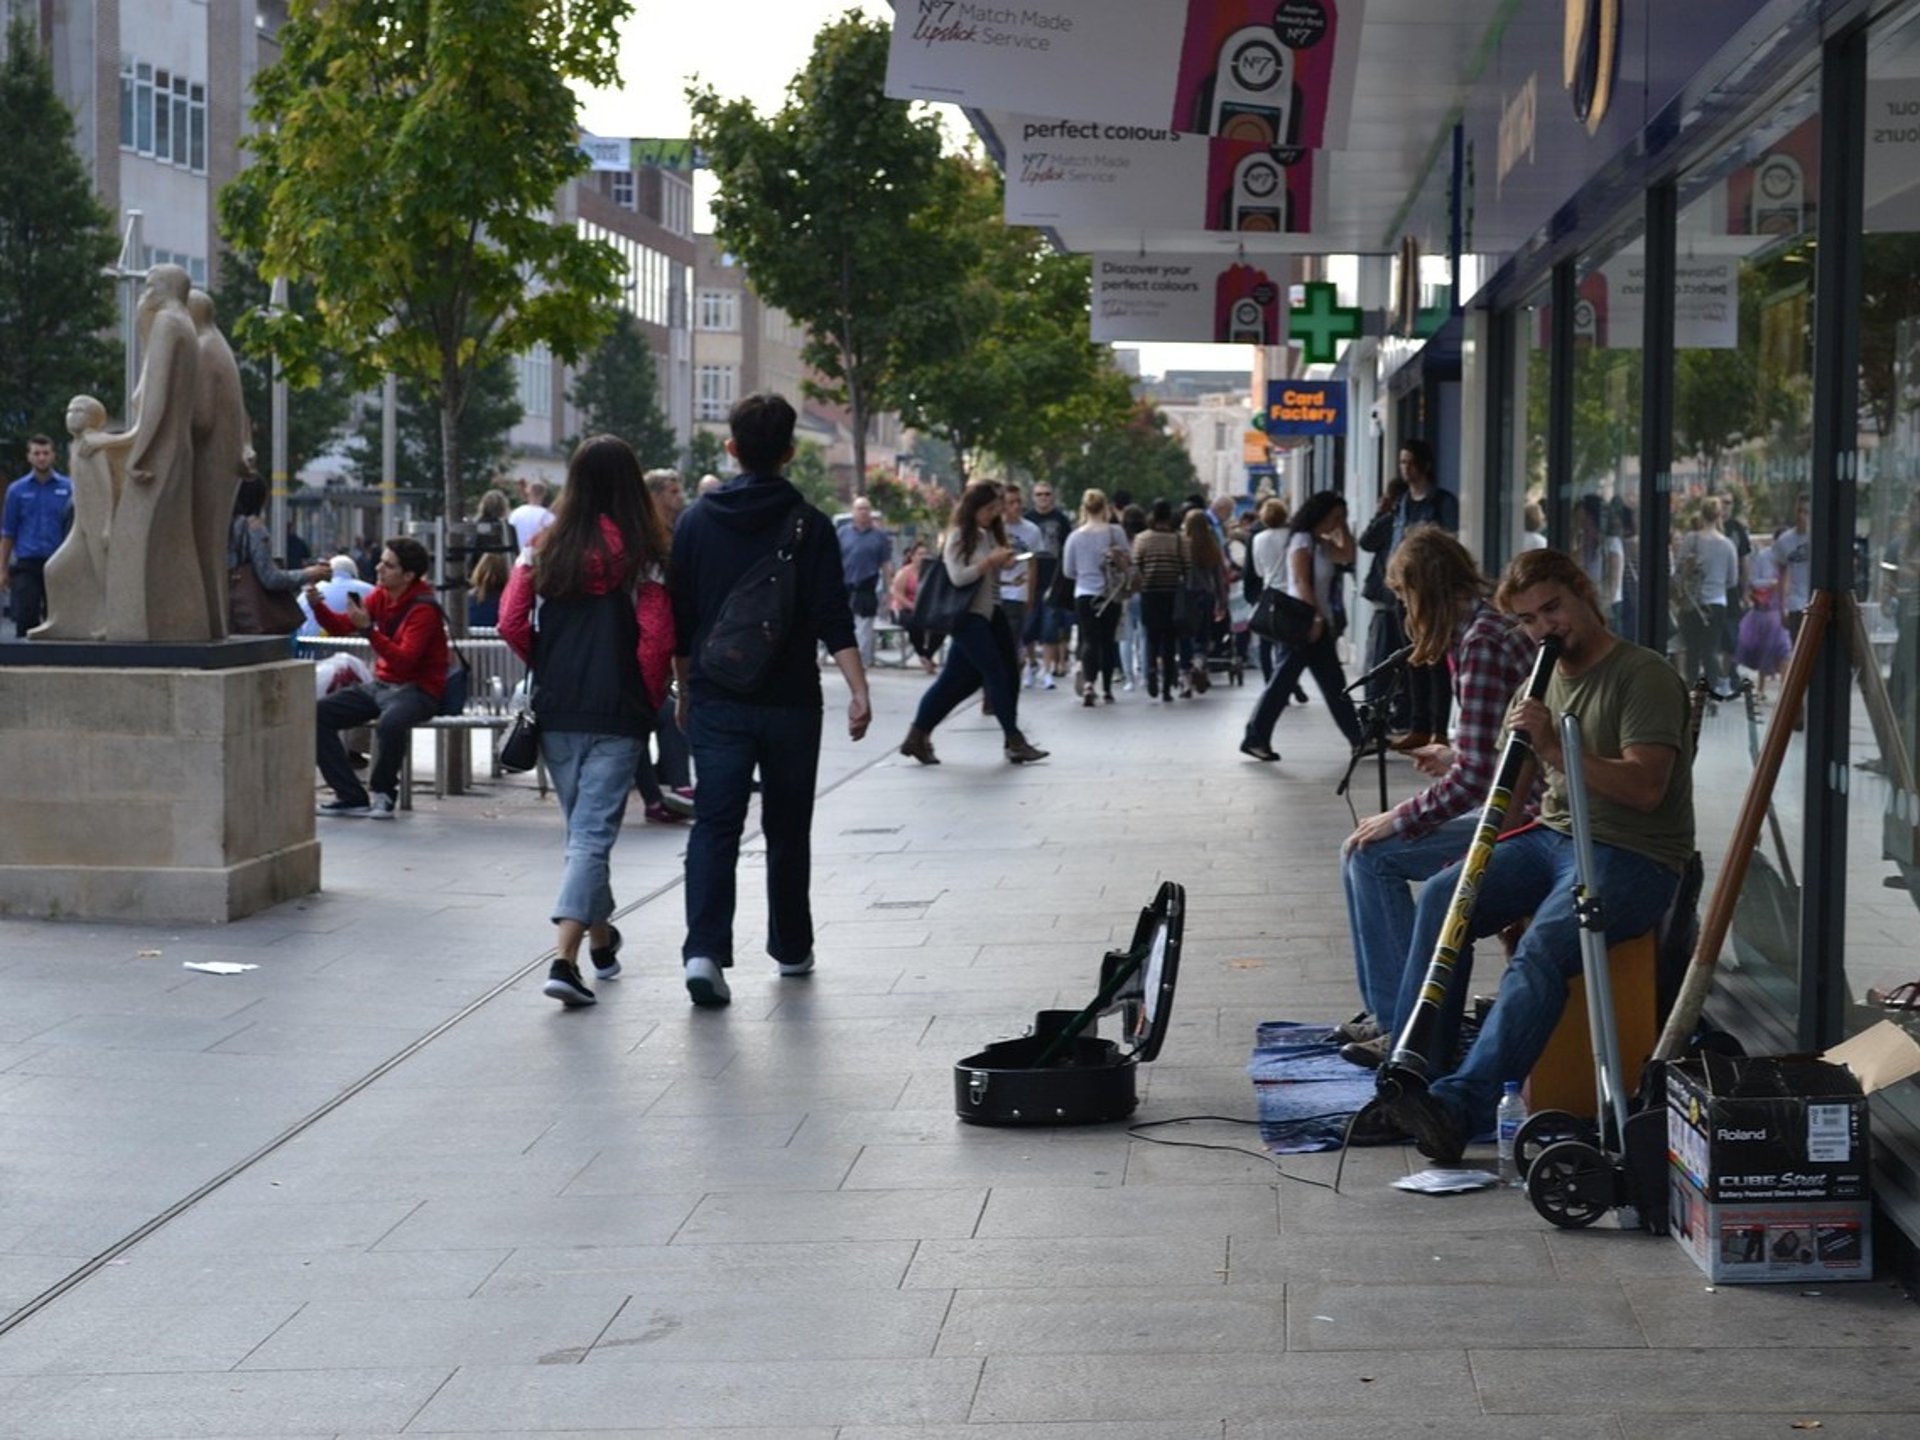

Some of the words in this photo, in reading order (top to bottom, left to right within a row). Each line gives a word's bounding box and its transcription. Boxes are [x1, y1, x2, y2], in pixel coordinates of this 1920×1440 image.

[959, 3, 1017, 26] Match
[1021, 10, 1073, 33] Made
[983, 27, 1050, 50] Service
[1023, 119, 1099, 142] perfect
[1101, 261, 1159, 276] Discover
[1162, 266, 1193, 278] your
[1101, 278, 1149, 292] perfect
[1151, 279, 1200, 292] colours
[1283, 390, 1325, 406] Card
[1270, 405, 1337, 424] Factory
[1717, 1128, 1766, 1140] Roland
[1718, 1174, 1777, 1186] CUBE
